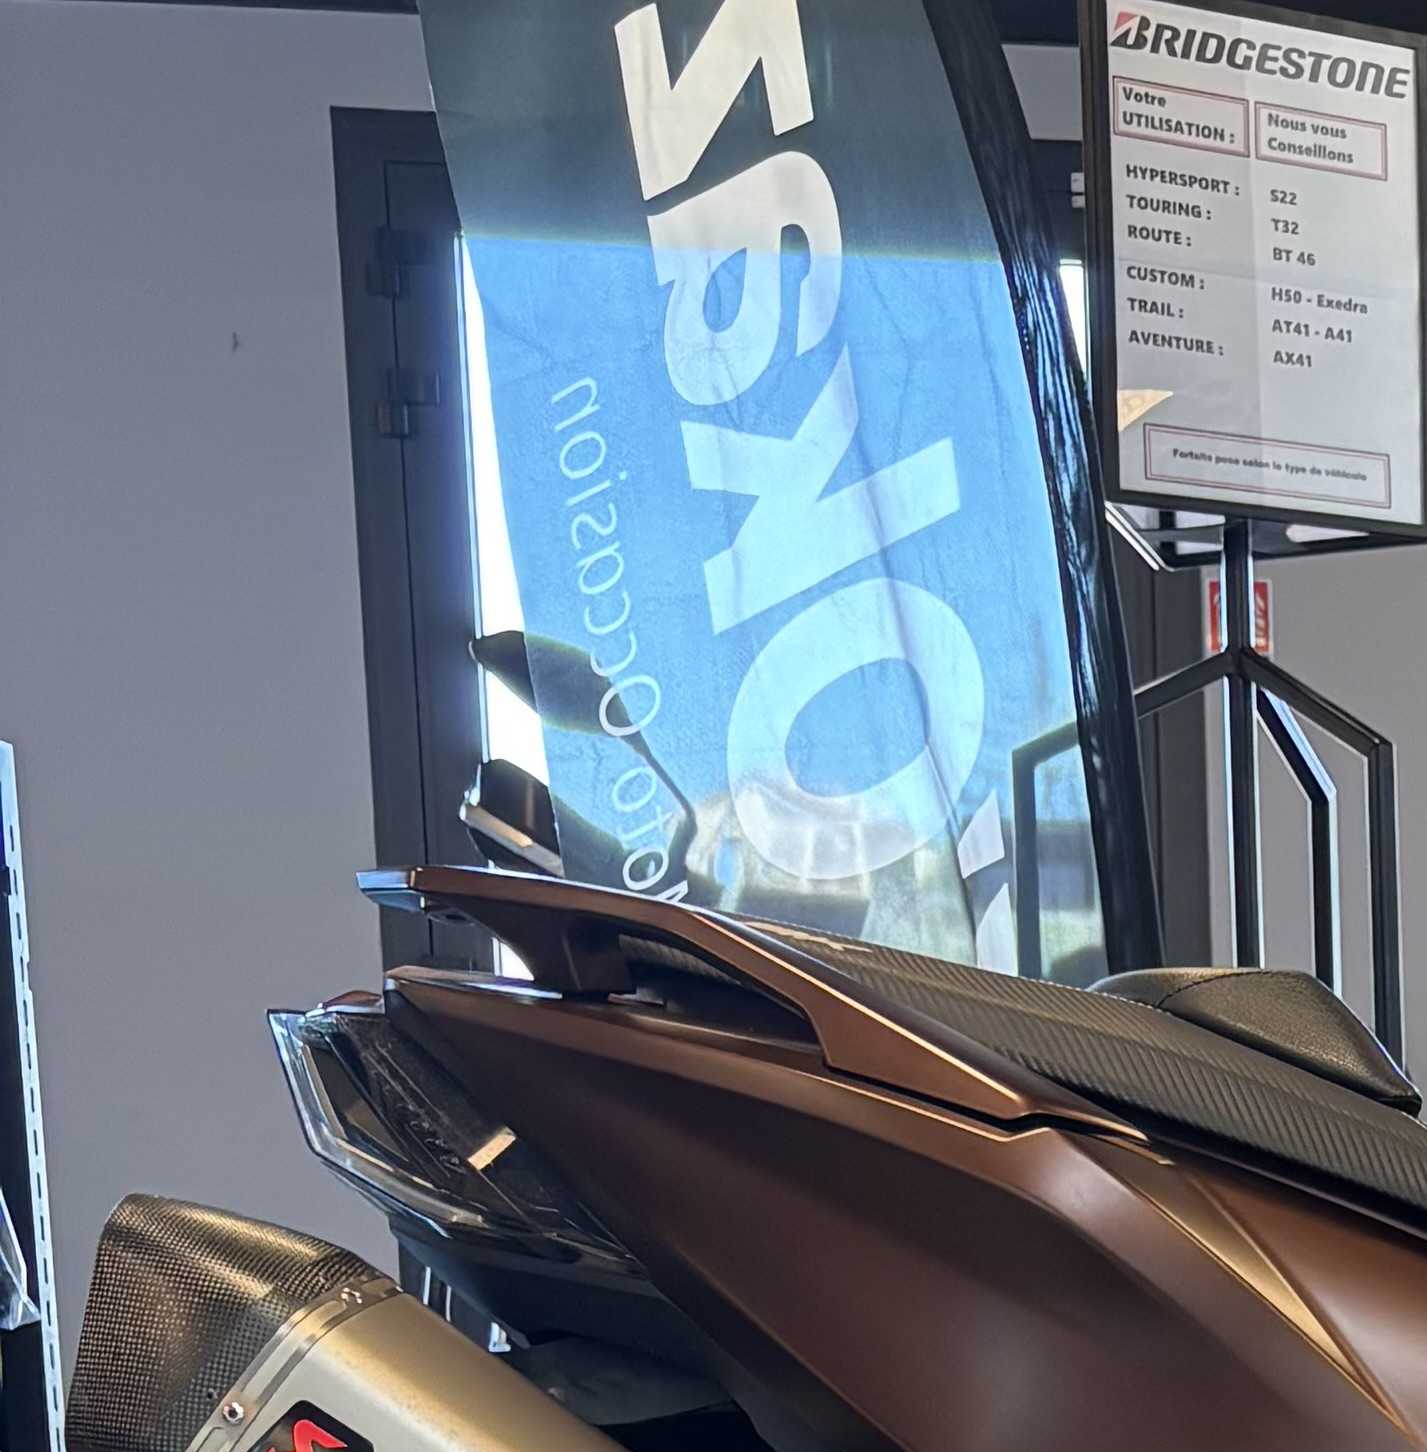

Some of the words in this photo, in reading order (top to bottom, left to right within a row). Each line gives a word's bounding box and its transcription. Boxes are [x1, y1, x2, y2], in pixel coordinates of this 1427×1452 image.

[1110, 11, 1411, 99] BRIDGESTONE
[1122, 87, 1167, 108] Votre
[1122, 111, 1225, 142] UTILISATION
[1268, 113, 1307, 132] Nous
[1311, 122, 1347, 140] vous
[1268, 137, 1353, 164] Conseillons
[1126, 164, 1231, 195] HYPERSPORT
[1126, 194, 1203, 219] TOURING
[1270, 189, 1298, 207] S22
[1127, 225, 1183, 246] ROUTE
[1271, 219, 1300, 236] T32
[1273, 247, 1293, 264] BT
[1297, 250, 1317, 267] 46
[1126, 265, 1196, 289] CUSTOM
[1127, 297, 1175, 318] TRAIL
[1271, 287, 1303, 304] H50
[1317, 294, 1369, 315] Exedra
[1128, 329, 1215, 355] AVENTURE
[1271, 319, 1310, 338] AT41
[1324, 325, 1353, 343] A41
[1273, 350, 1313, 368] AX41
